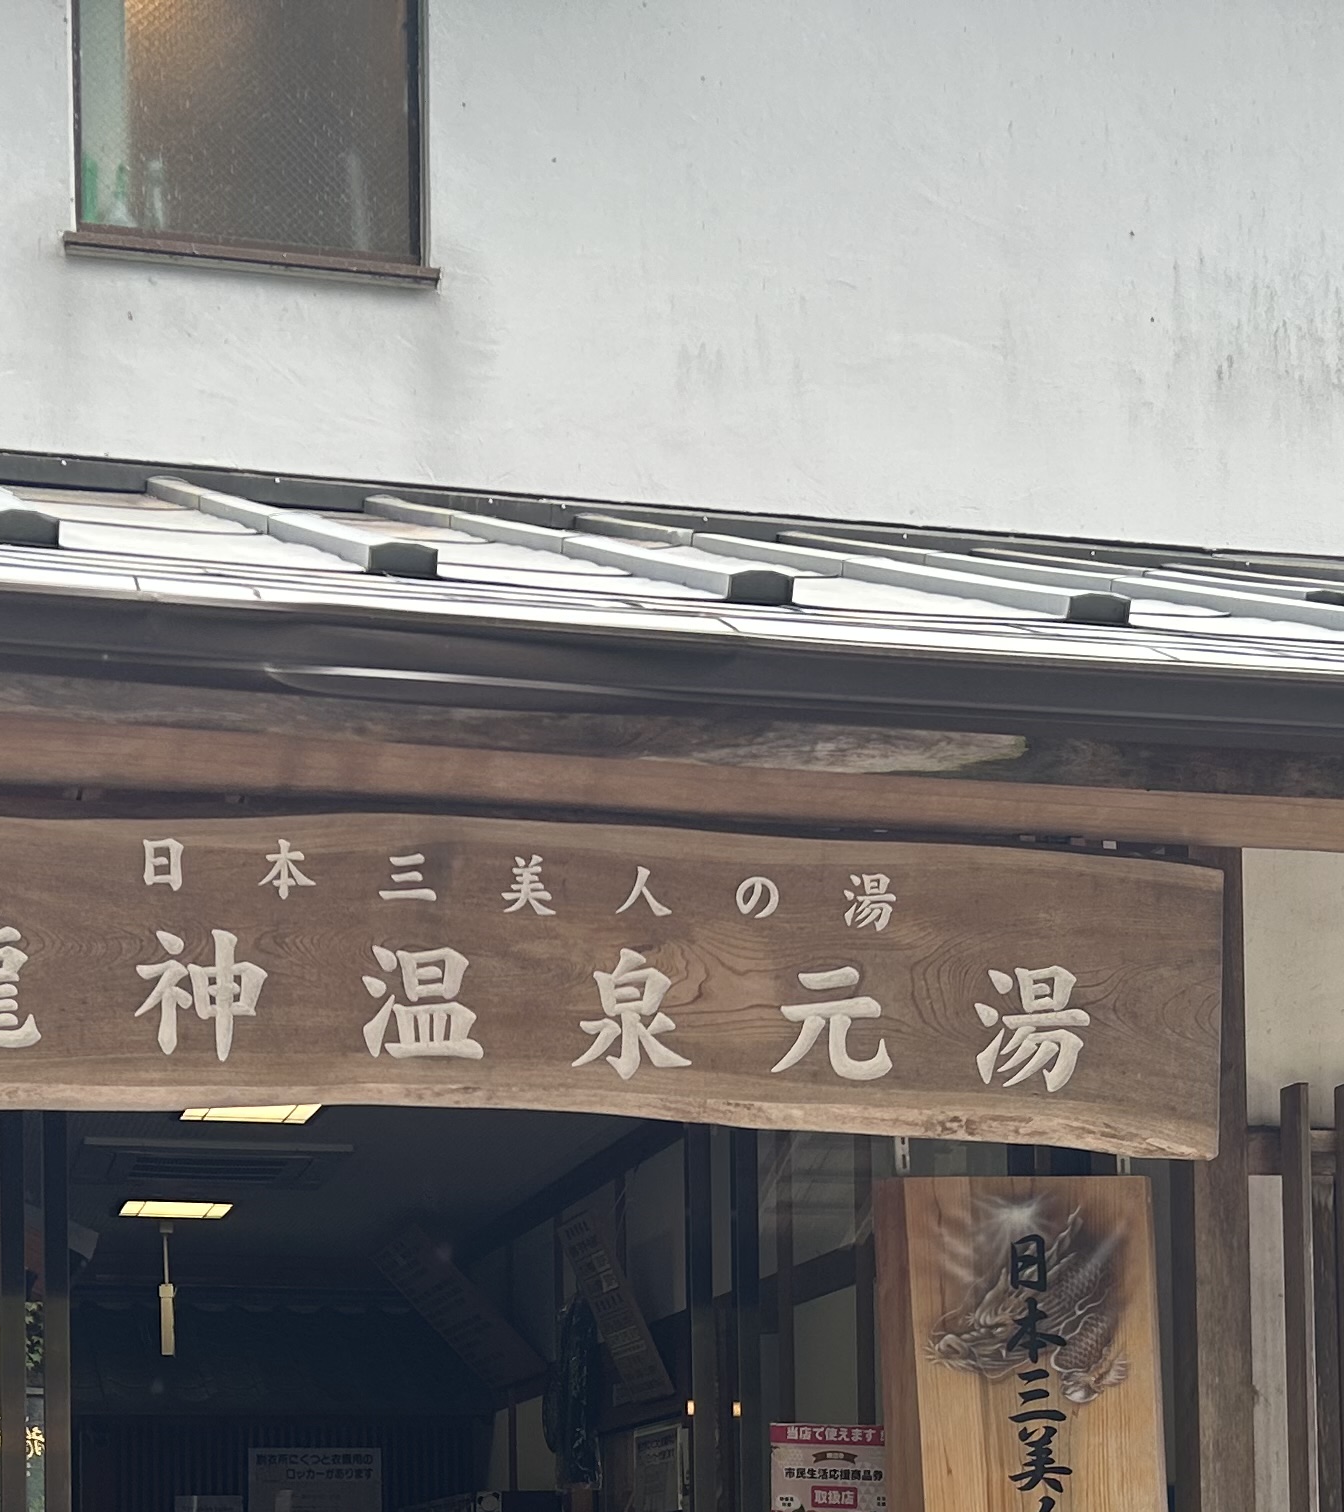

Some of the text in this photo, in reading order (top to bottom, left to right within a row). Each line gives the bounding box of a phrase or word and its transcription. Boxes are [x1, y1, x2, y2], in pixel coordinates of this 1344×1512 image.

[142, 838, 897, 933] 日本三美人の湯
[786, 1427, 877, 1443] 当店で使えます
[814, 1489, 855, 1505] 取扱店
